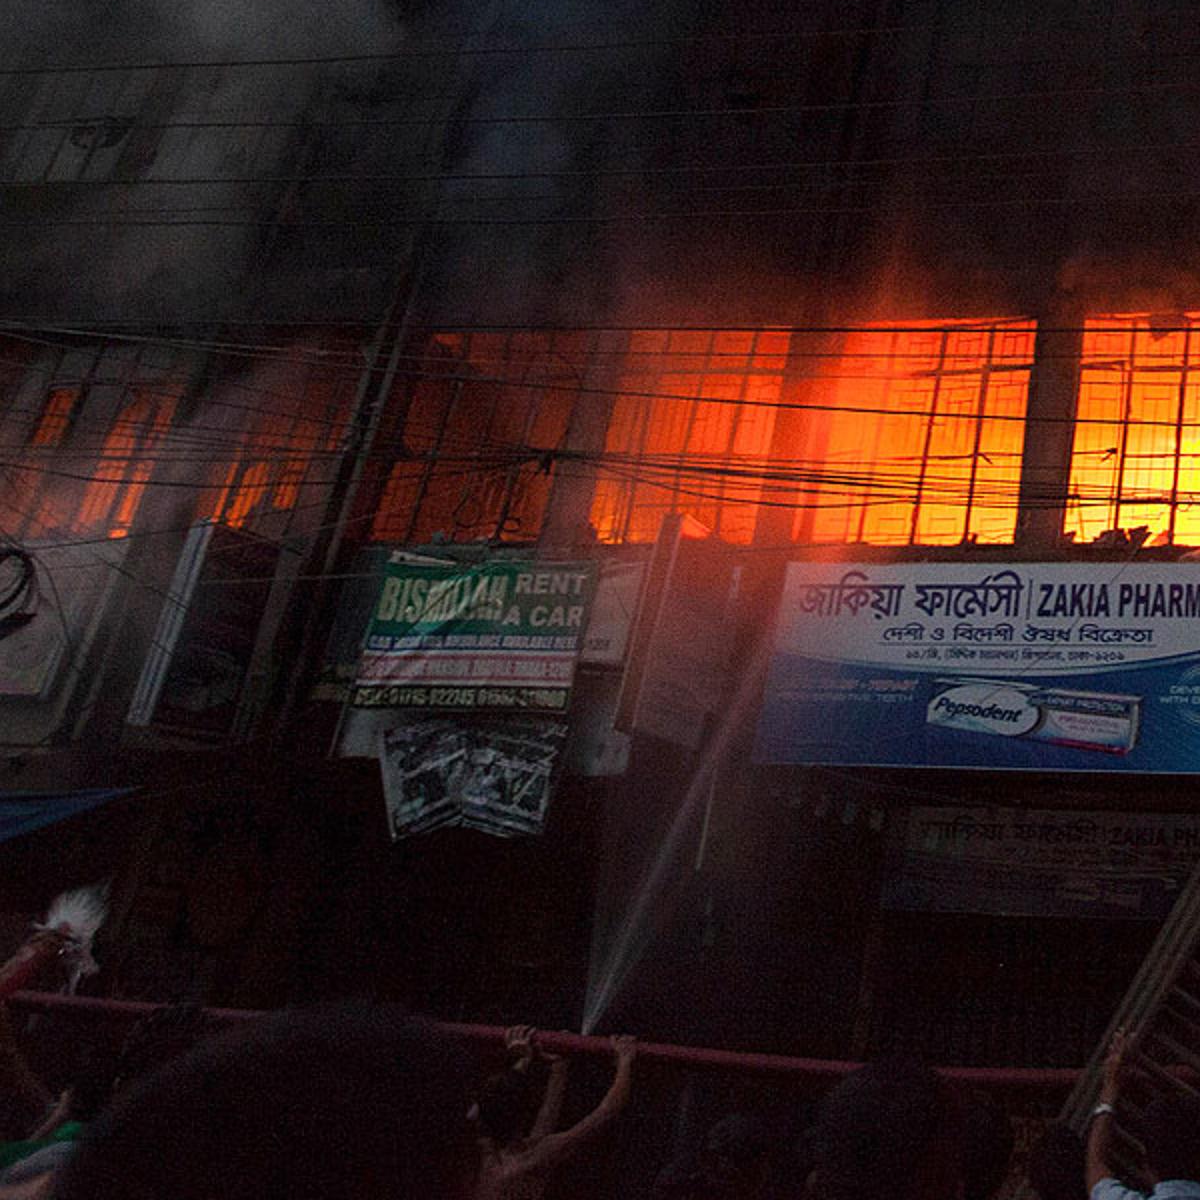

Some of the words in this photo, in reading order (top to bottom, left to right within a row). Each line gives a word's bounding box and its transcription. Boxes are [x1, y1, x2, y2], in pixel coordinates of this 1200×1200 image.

[514, 573, 586, 595] RENT
[798, 571, 905, 619] জাকিয়া
[914, 570, 1023, 618] ফার্মেসী
[1036, 583, 1110, 617] ZAKIA
[501, 605, 520, 627] A
[529, 606, 583, 627] CAR
[883, 622, 925, 641] দেশী
[930, 626, 944, 641] ও
[953, 622, 1015, 641] বিদেশী
[1079, 623, 1154, 642] বিক্রেতা
[932, 697, 1023, 723] Pepsodent
